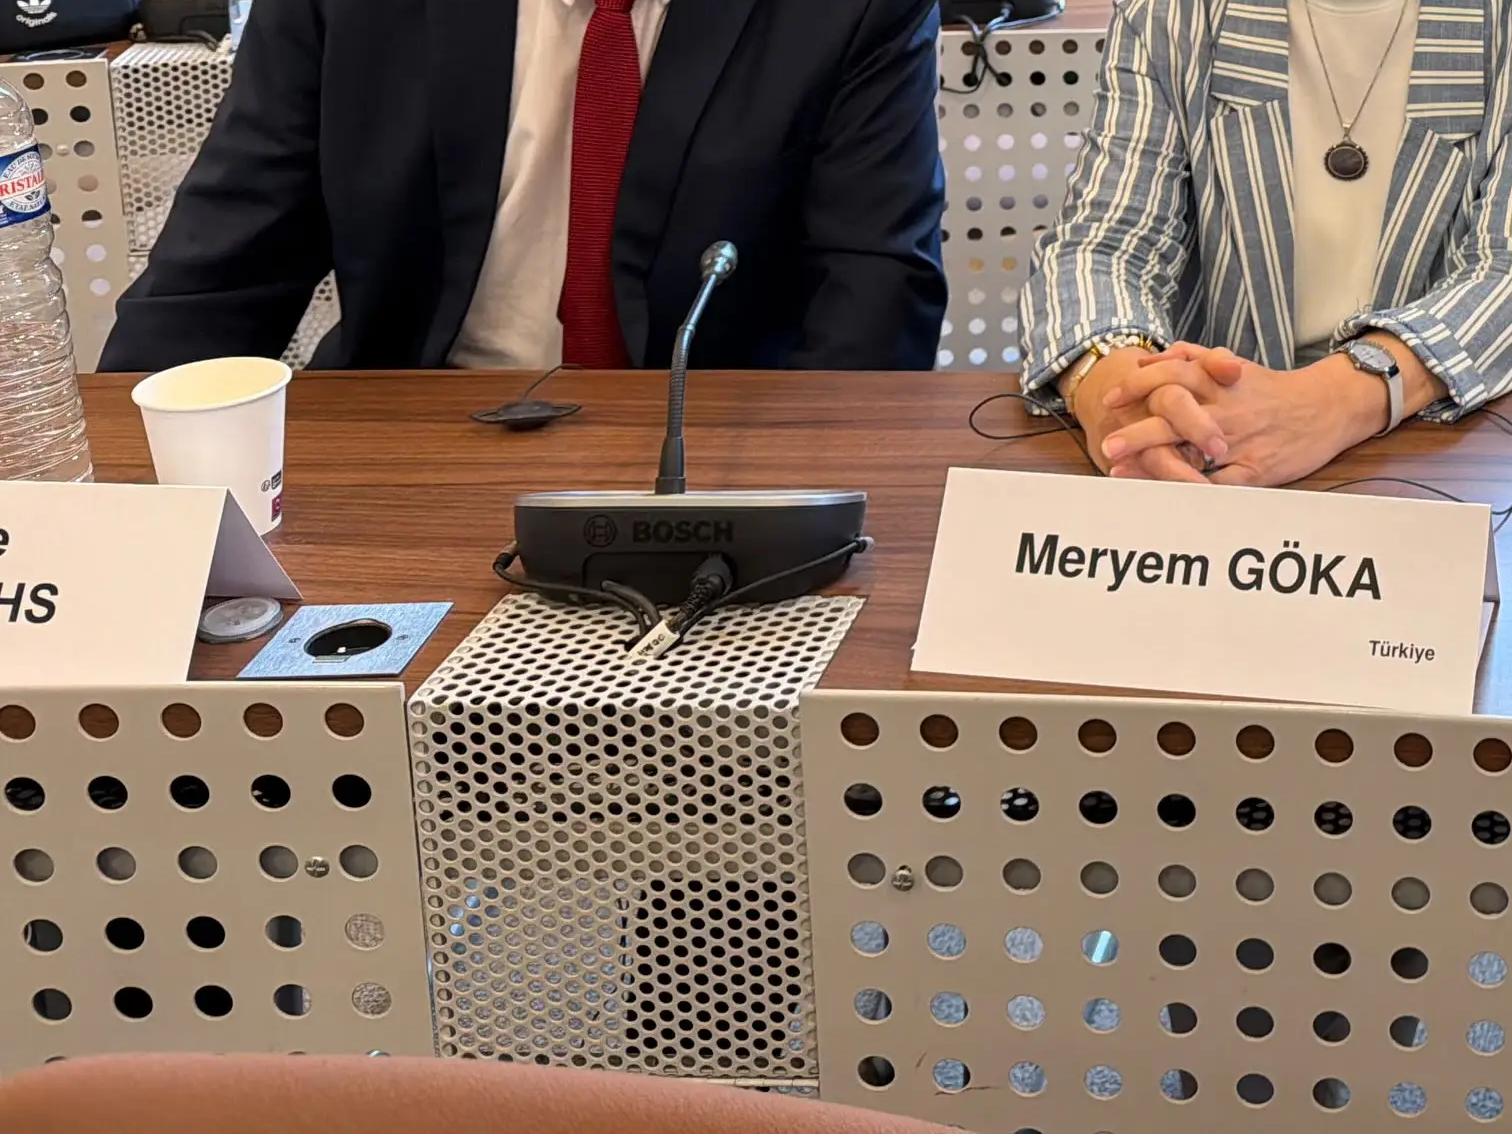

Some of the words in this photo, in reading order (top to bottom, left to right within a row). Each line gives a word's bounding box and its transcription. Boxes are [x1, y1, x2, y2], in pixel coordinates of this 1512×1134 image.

[632, 520, 734, 544] BOSCH
[1014, 531, 1211, 592] Meryem
[1227, 540, 1382, 601] GÖKA
[1368, 639, 1436, 664] Türkiye
